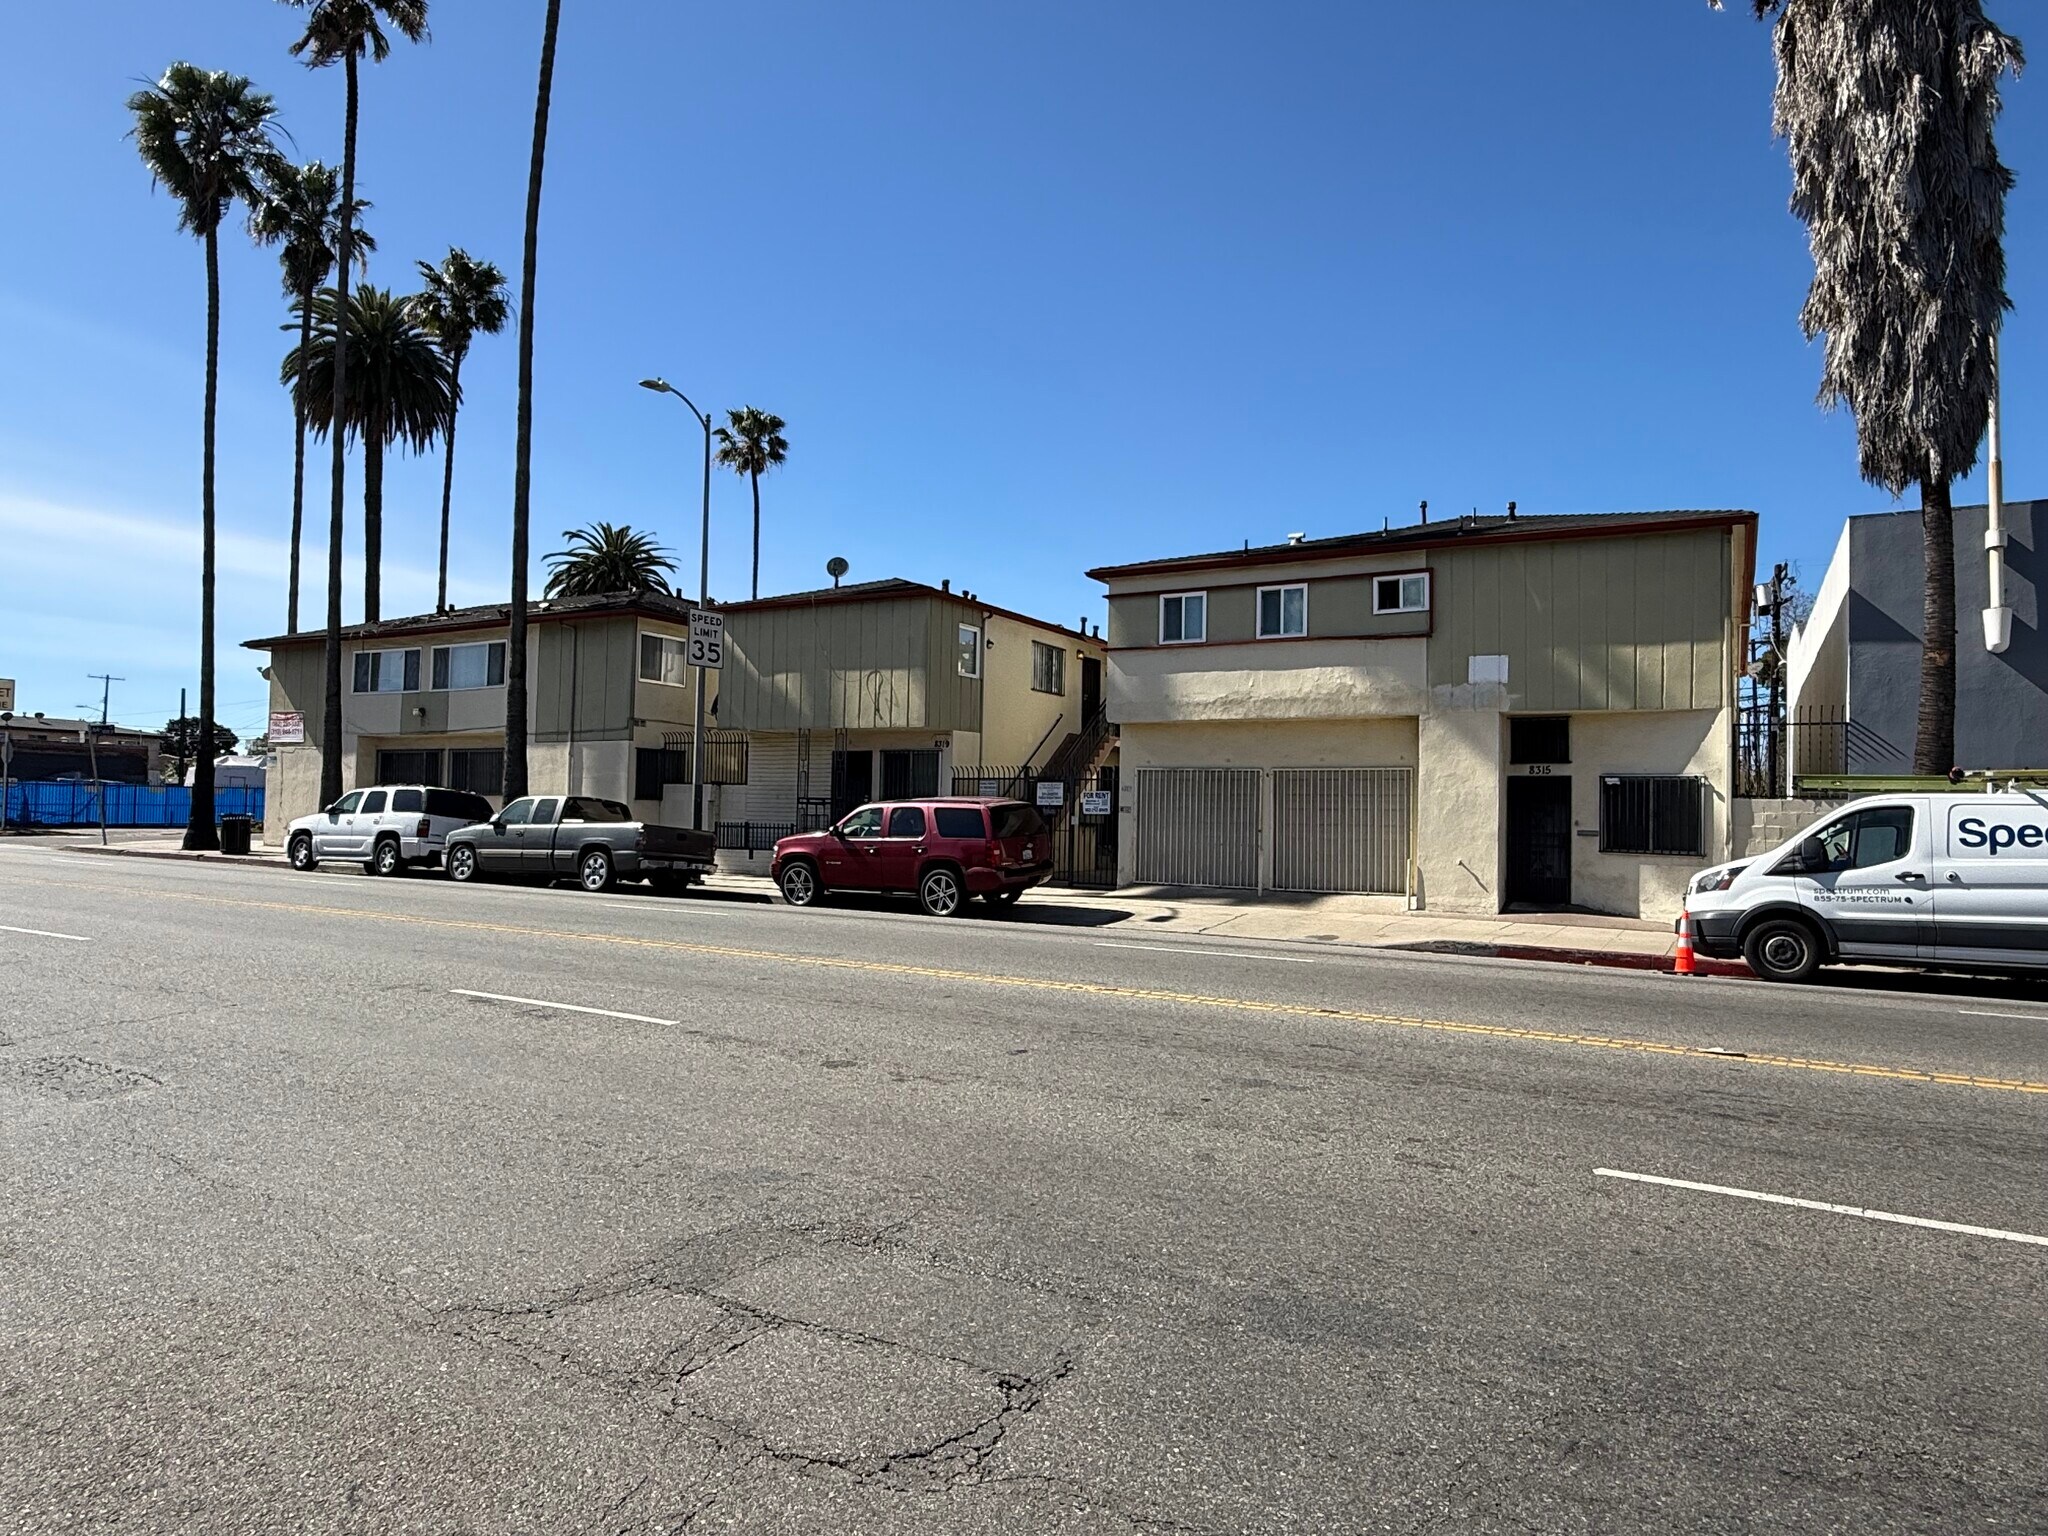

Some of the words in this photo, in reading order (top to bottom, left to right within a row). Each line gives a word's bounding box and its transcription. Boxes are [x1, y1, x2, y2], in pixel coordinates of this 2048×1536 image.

[691, 613, 723, 627] SPEED
[694, 626, 719, 639] LIMIT
[691, 639, 721, 664] 35
[1528, 765, 1552, 775] 8315
[1095, 792, 1110, 800] RENT
[1958, 817, 2048, 856] Spe
[1813, 887, 1890, 896] spectrum.com
[1814, 895, 1902, 903] 855-75-SPECTRUM
